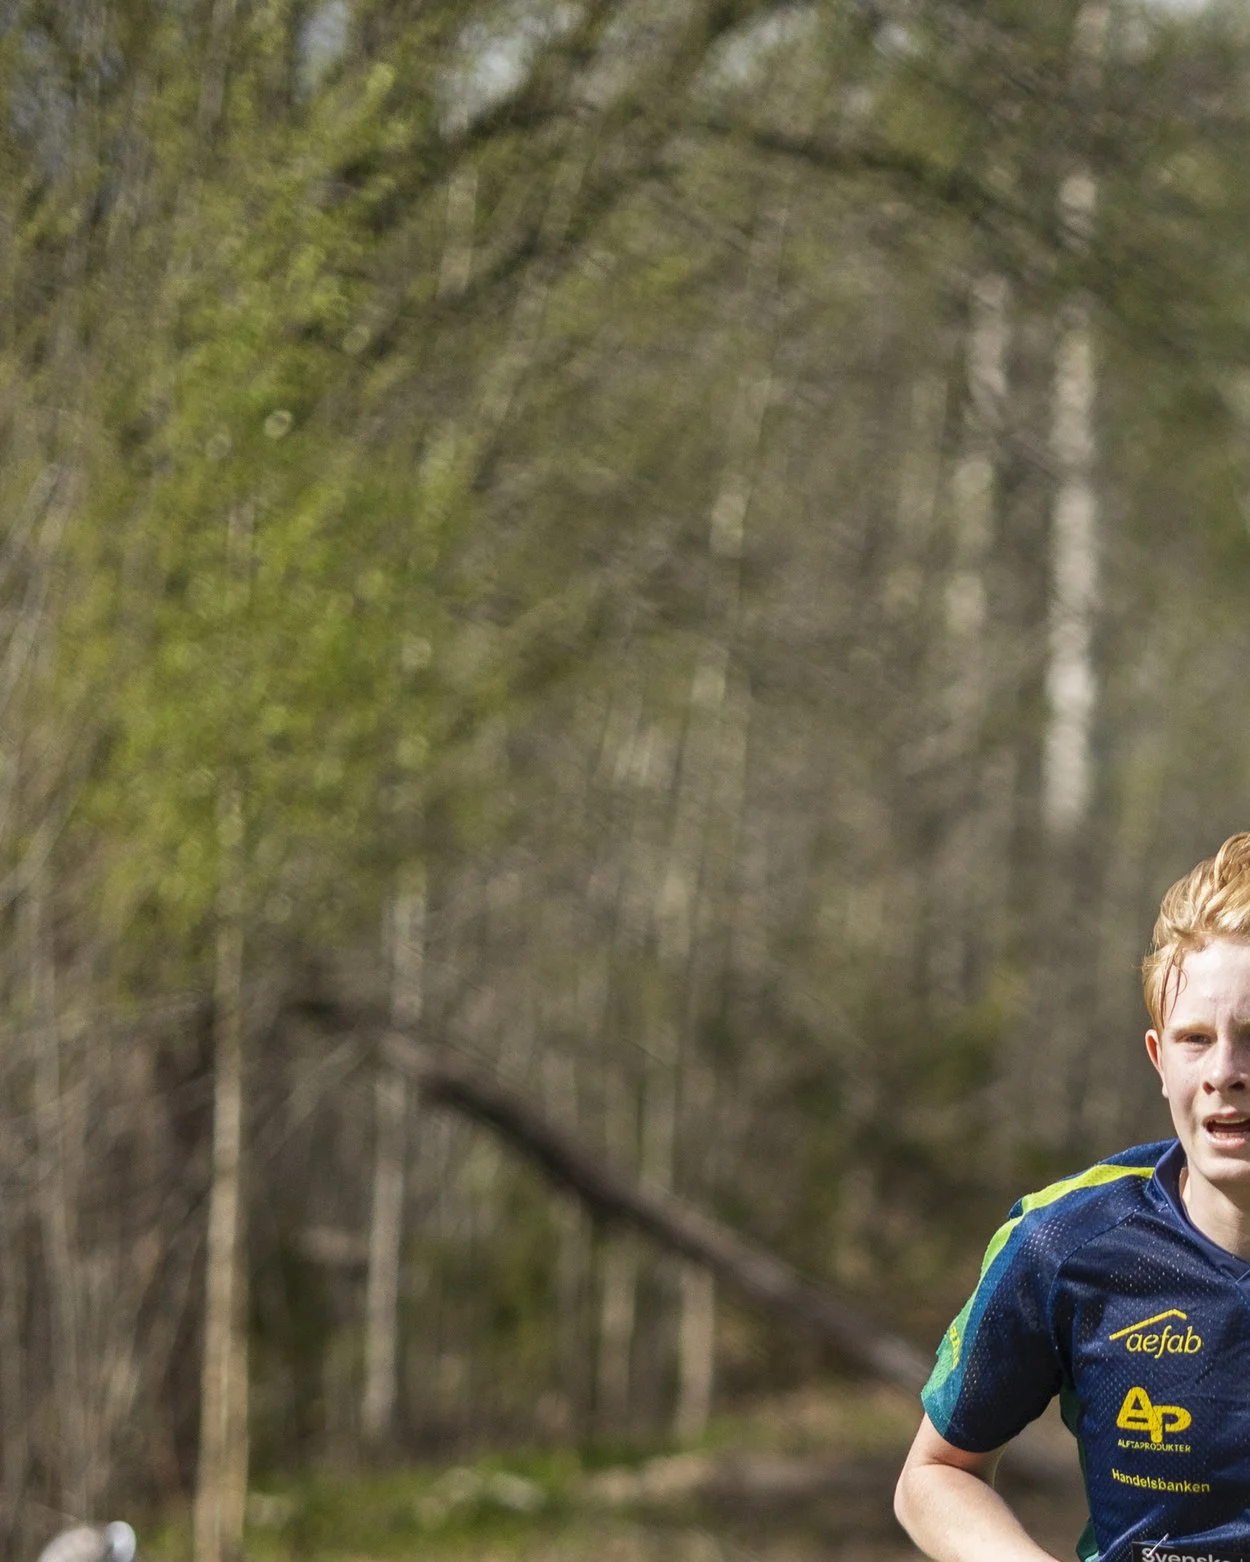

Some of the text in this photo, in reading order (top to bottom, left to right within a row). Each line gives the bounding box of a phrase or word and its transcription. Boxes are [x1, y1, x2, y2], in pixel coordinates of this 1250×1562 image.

[1125, 1324, 1202, 1359] aefab
[1116, 1386, 1192, 1443] AP
[1111, 1468, 1210, 1492] Handelsbanken
